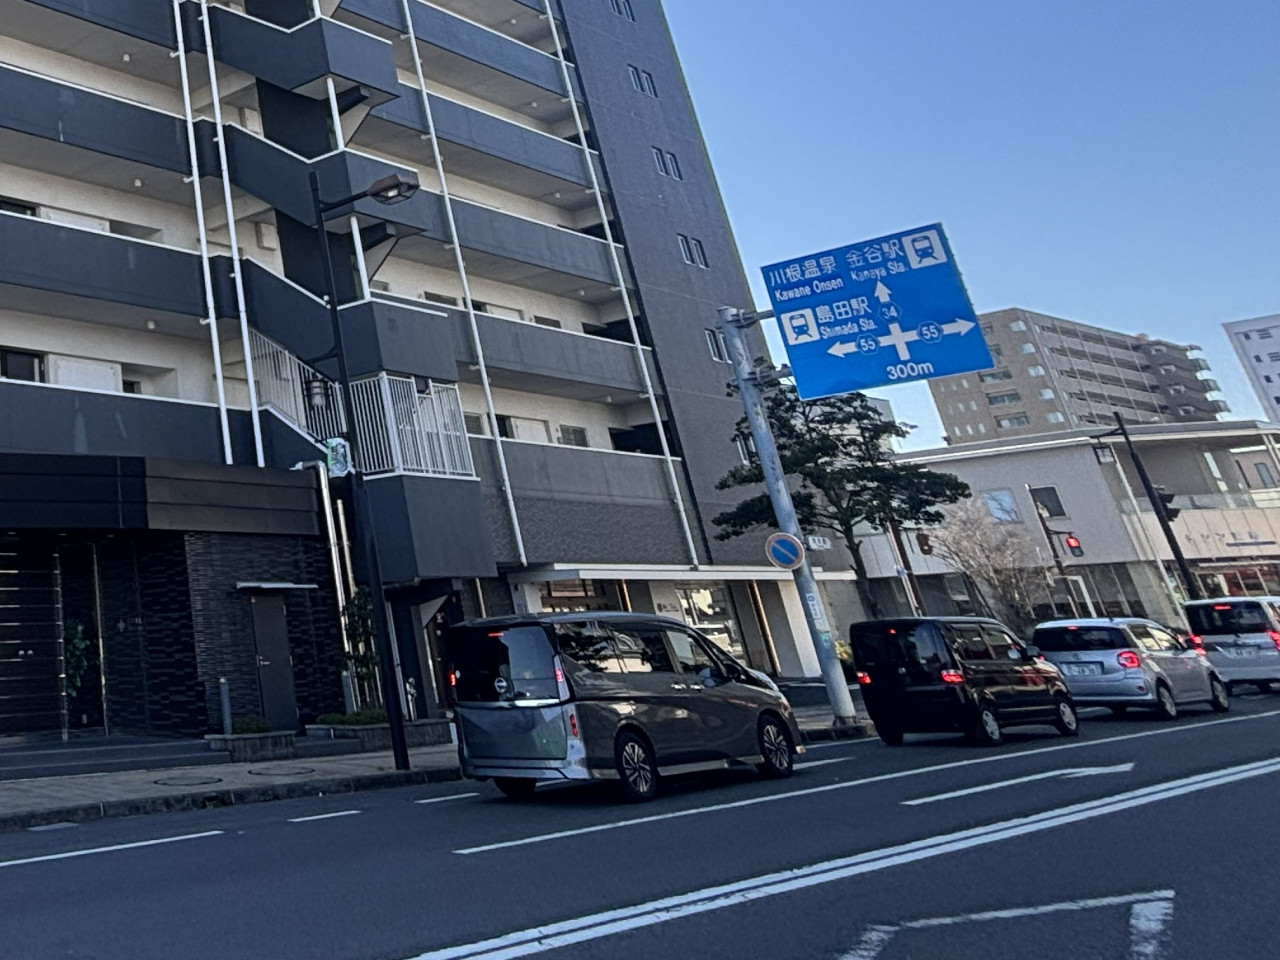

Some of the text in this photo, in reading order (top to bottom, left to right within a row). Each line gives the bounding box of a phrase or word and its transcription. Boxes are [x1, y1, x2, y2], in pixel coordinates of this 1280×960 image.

[845, 239, 904, 268] 金谷駅
[770, 255, 837, 287] 川根温泉
[850, 261, 909, 282] Kanaya Sta.
[774, 278, 844, 302] Kawane Onsen
[815, 296, 872, 323] 島田駅
[881, 306, 898, 320] 34
[820, 317, 878, 339] Shimada Sta.
[921, 325, 939, 340] 55
[860, 337, 876, 352] 55
[886, 362, 935, 381] 300m
